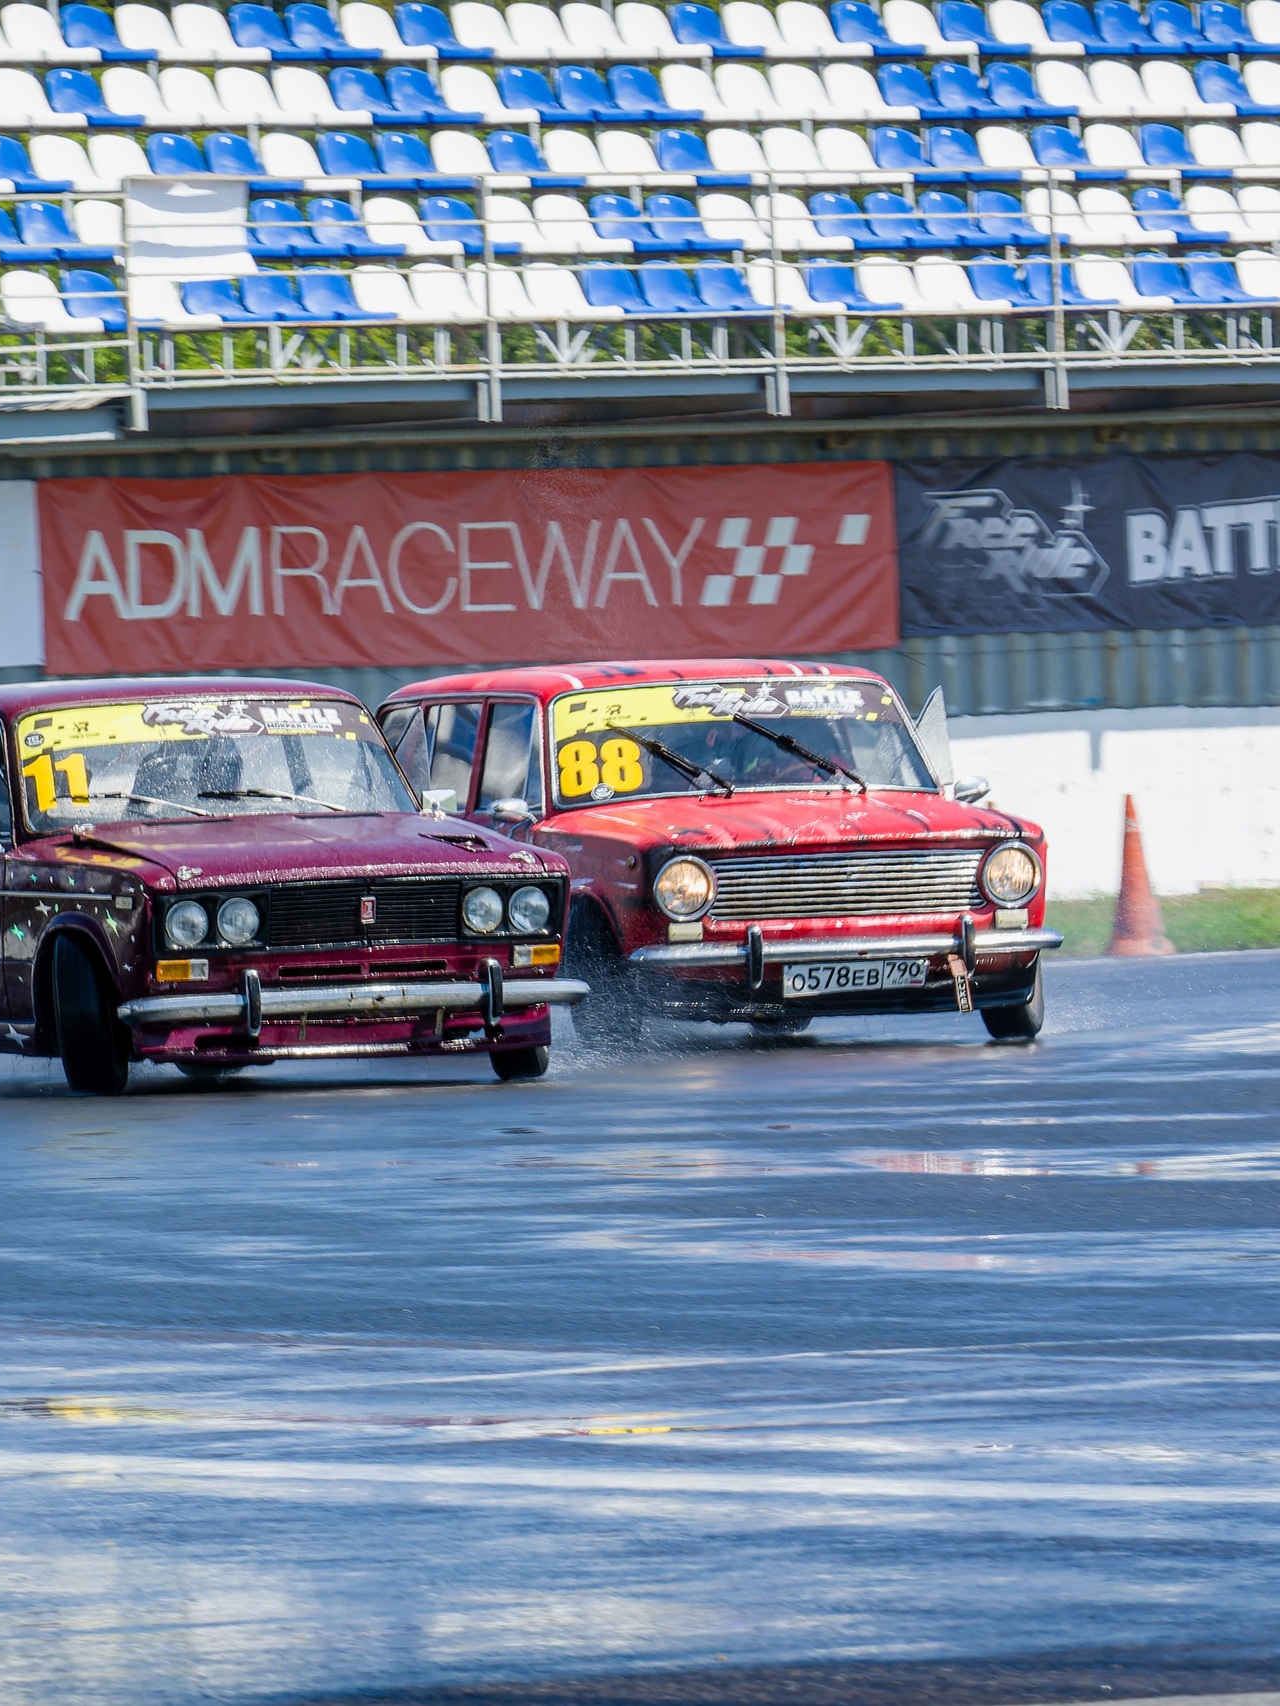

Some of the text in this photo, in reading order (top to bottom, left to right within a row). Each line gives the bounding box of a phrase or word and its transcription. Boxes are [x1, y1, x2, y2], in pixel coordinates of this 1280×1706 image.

[63, 516, 706, 622] ADMRACEWAY
[1127, 495, 1280, 586] BATT
[258, 706, 342, 726] BATTLE
[784, 689, 866, 707] BATTLE
[23, 753, 90, 812] 11
[558, 739, 643, 797] 88
[886, 961, 920, 979] 790
